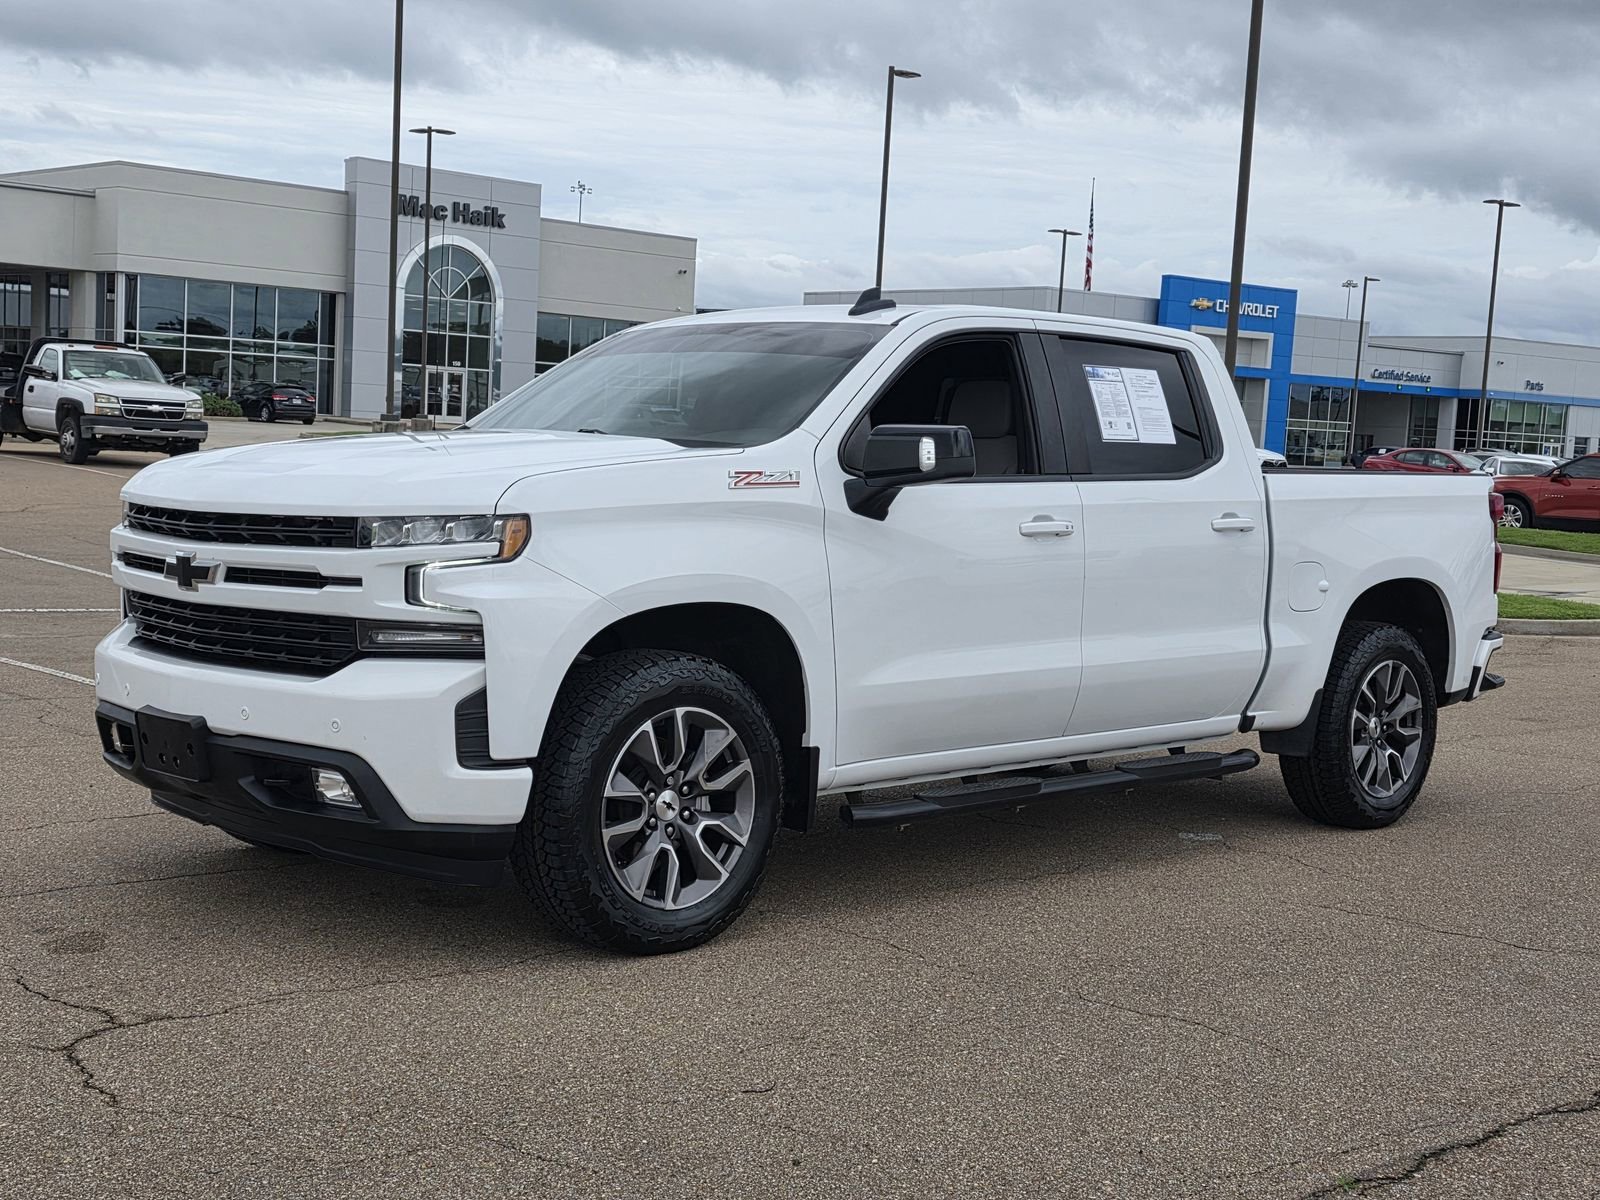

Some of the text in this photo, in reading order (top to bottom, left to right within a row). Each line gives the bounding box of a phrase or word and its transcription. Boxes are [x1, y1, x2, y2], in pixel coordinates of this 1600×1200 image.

[398, 193, 506, 229] Mac Haik
[1216, 299, 1279, 318] CHVROLET
[1371, 368, 1431, 383] Certified Service
[1523, 379, 1545, 392] Parts
